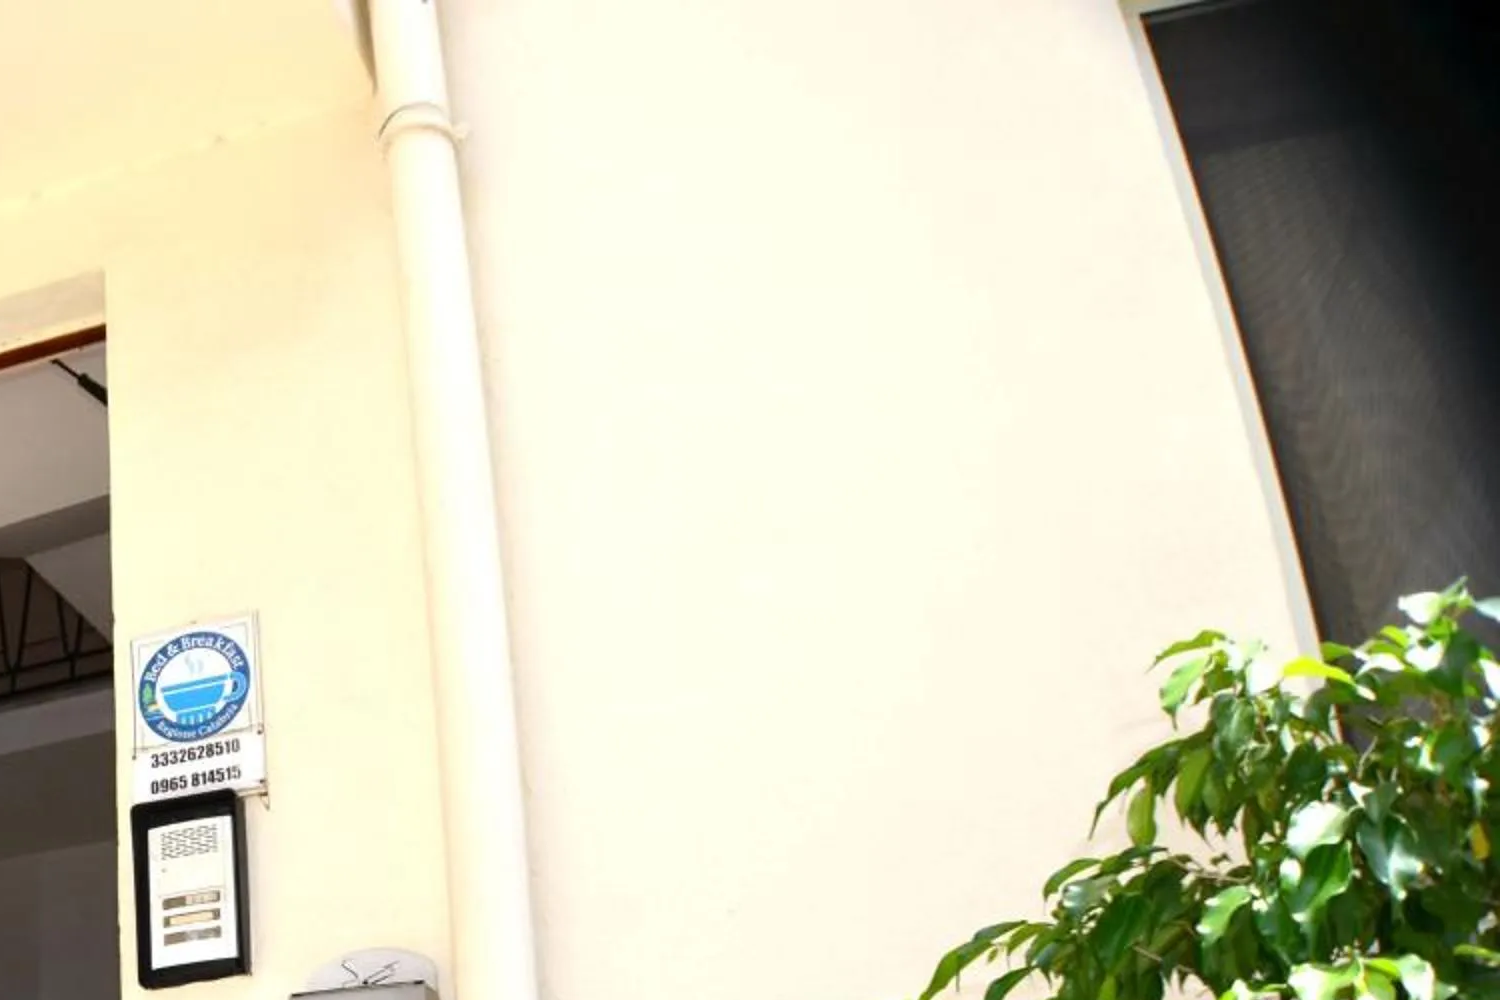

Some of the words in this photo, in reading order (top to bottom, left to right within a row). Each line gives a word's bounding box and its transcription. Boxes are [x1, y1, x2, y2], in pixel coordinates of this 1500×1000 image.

[144, 653, 167, 682] Bed
[167, 643, 179, 656] &
[180, 637, 243, 670] Breakfast
[151, 738, 240, 768] 3332628510
[151, 775, 187, 794] 0965
[191, 765, 241, 787] 814515
